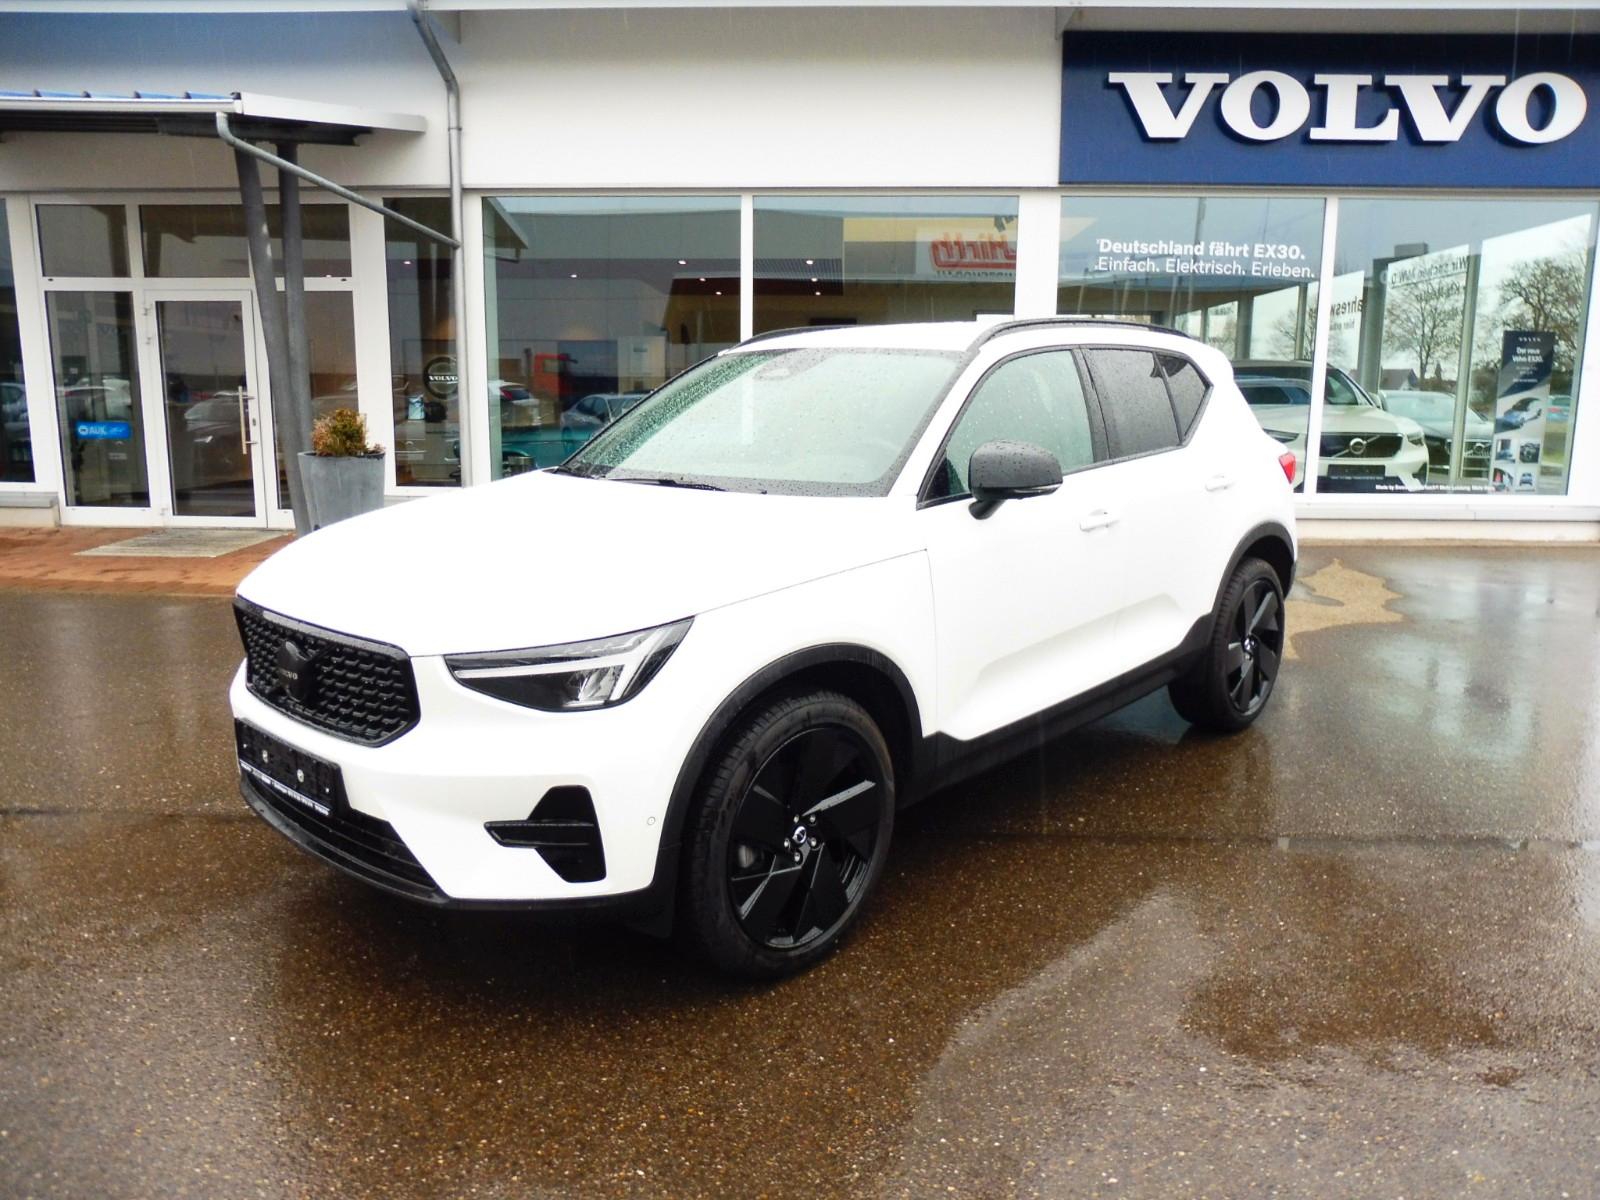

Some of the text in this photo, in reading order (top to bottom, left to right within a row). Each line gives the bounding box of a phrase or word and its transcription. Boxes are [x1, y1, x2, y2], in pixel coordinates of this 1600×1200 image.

[1108, 70, 1588, 144] VOLVO
[1099, 238, 1306, 260] Deutschland fährt EX30.
[1098, 257, 1315, 278] Einfach. Elektrisch. Erleben.
